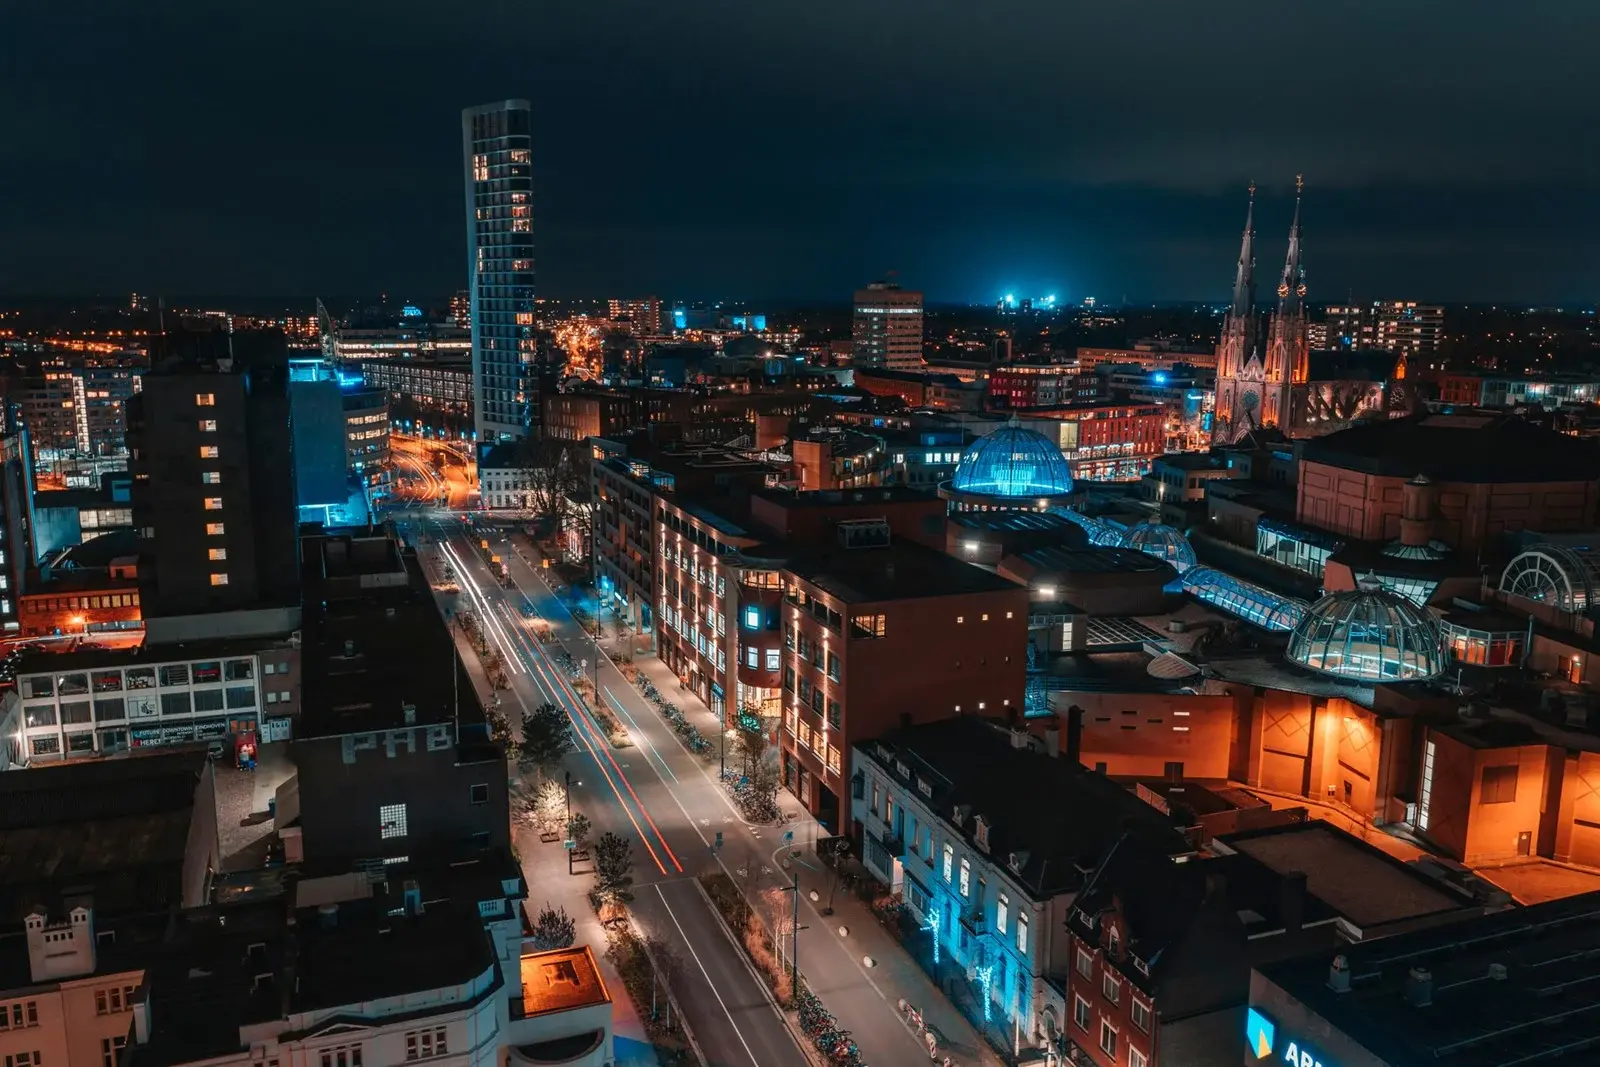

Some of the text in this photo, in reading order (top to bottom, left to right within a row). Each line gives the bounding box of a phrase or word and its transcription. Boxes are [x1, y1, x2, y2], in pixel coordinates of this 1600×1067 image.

[162, 726, 193, 734] DOWNTOWN
[194, 722, 225, 731] EINDHOVEN
[1285, 1042, 1322, 1067] AB
